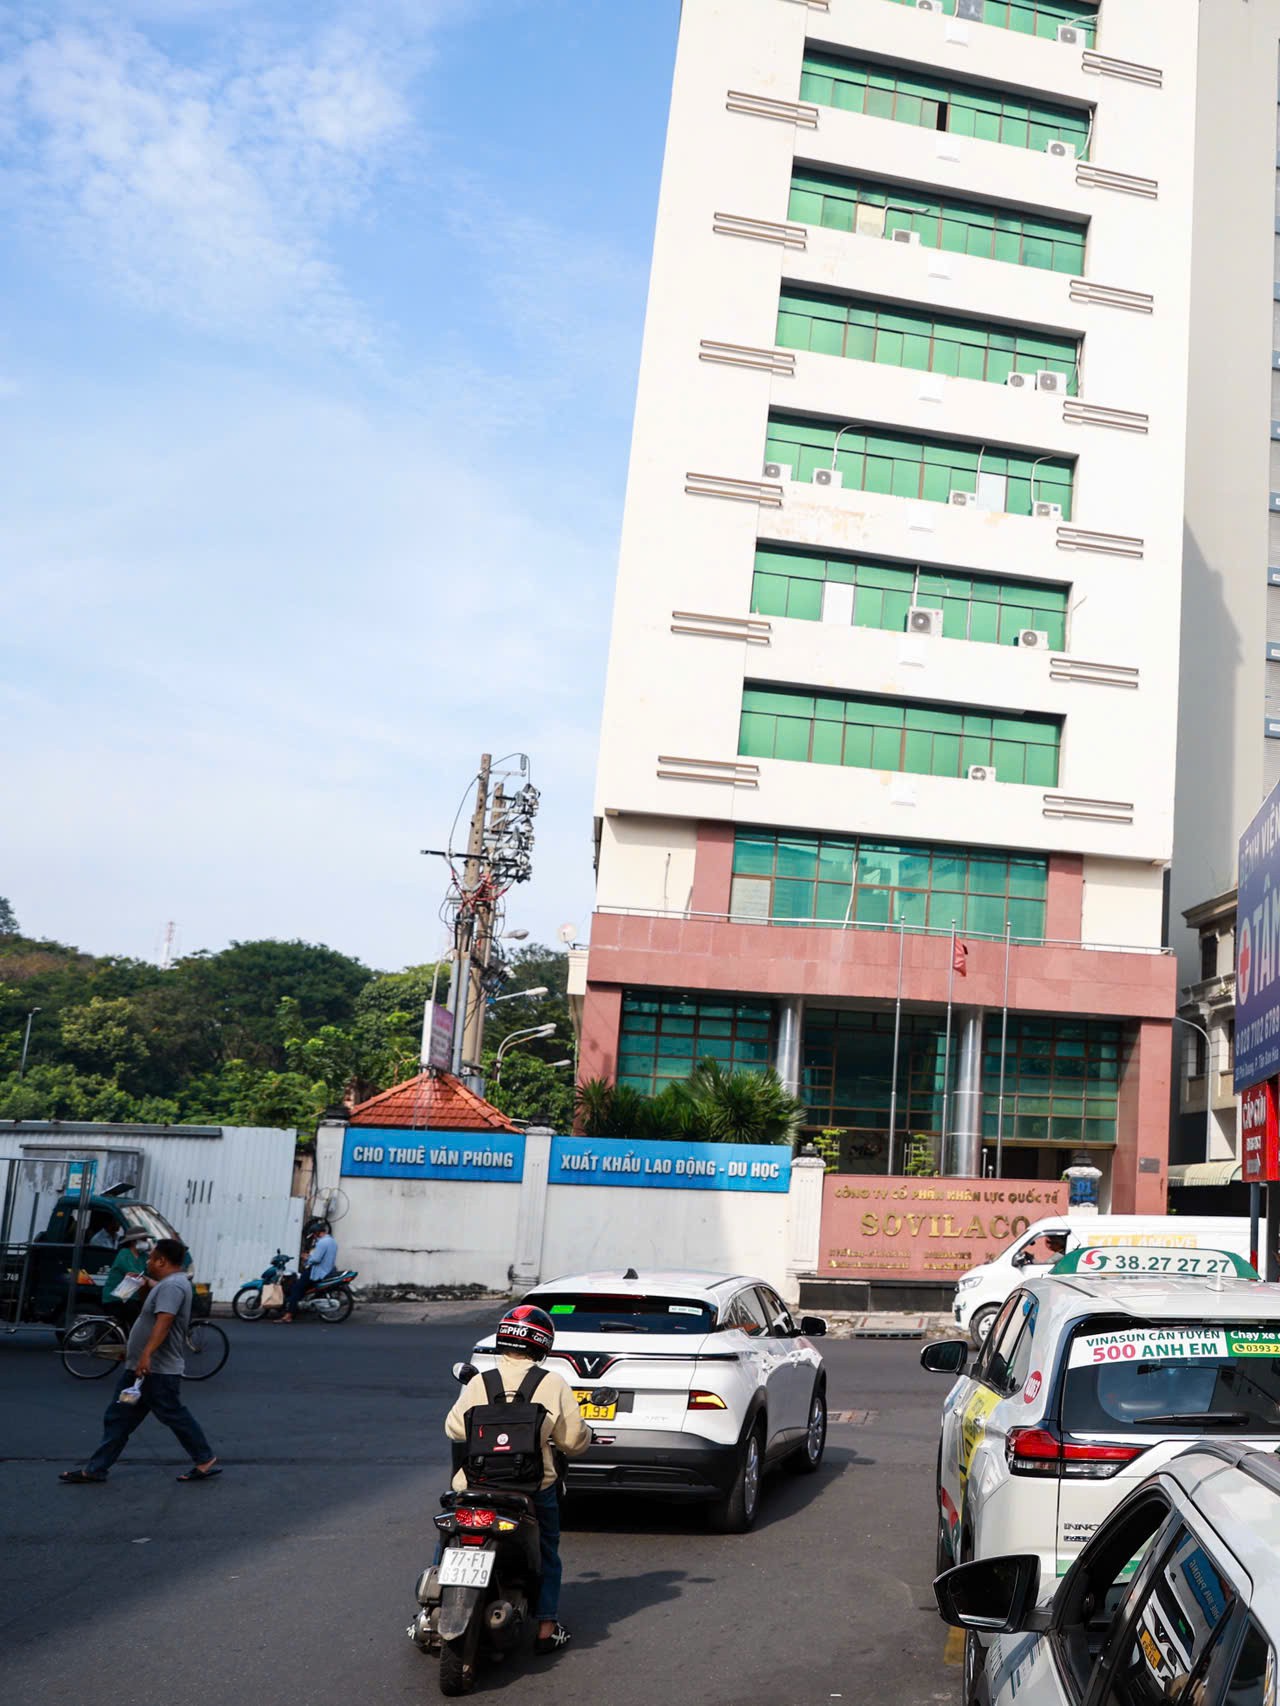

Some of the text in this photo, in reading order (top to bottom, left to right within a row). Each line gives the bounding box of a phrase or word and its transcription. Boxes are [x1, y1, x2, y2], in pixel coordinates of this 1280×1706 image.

[353, 1144, 514, 1169] CHO THUÊ VĂN PHÒNG
[560, 1149, 599, 1172] XUẤT
[602, 1150, 641, 1174] KHẨU
[645, 1156, 673, 1175] LAO
[675, 1156, 716, 1180] ĐỘNG
[728, 1160, 748, 1178] DU
[751, 1162, 779, 1182] HỌC
[835, 1186, 870, 1200] CÔNG
[872, 1189, 888, 1200] TY
[984, 1190, 1005, 1204] LỰC
[1008, 1188, 1041, 1204] QUỐC
[1044, 1189, 1060, 1204] TẾ
[860, 1211, 1031, 1239] SOVILACO
[1115, 1255, 1230, 1273] 38.27 27 27
[1086, 1333, 1145, 1347] VINASUN
[1230, 1330, 1259, 1341] Chạy
[1093, 1343, 1218, 1362] 500 ANH EM
[1246, 1345, 1272, 1353] 0393
[1063, 1523, 1100, 1531] INNO
